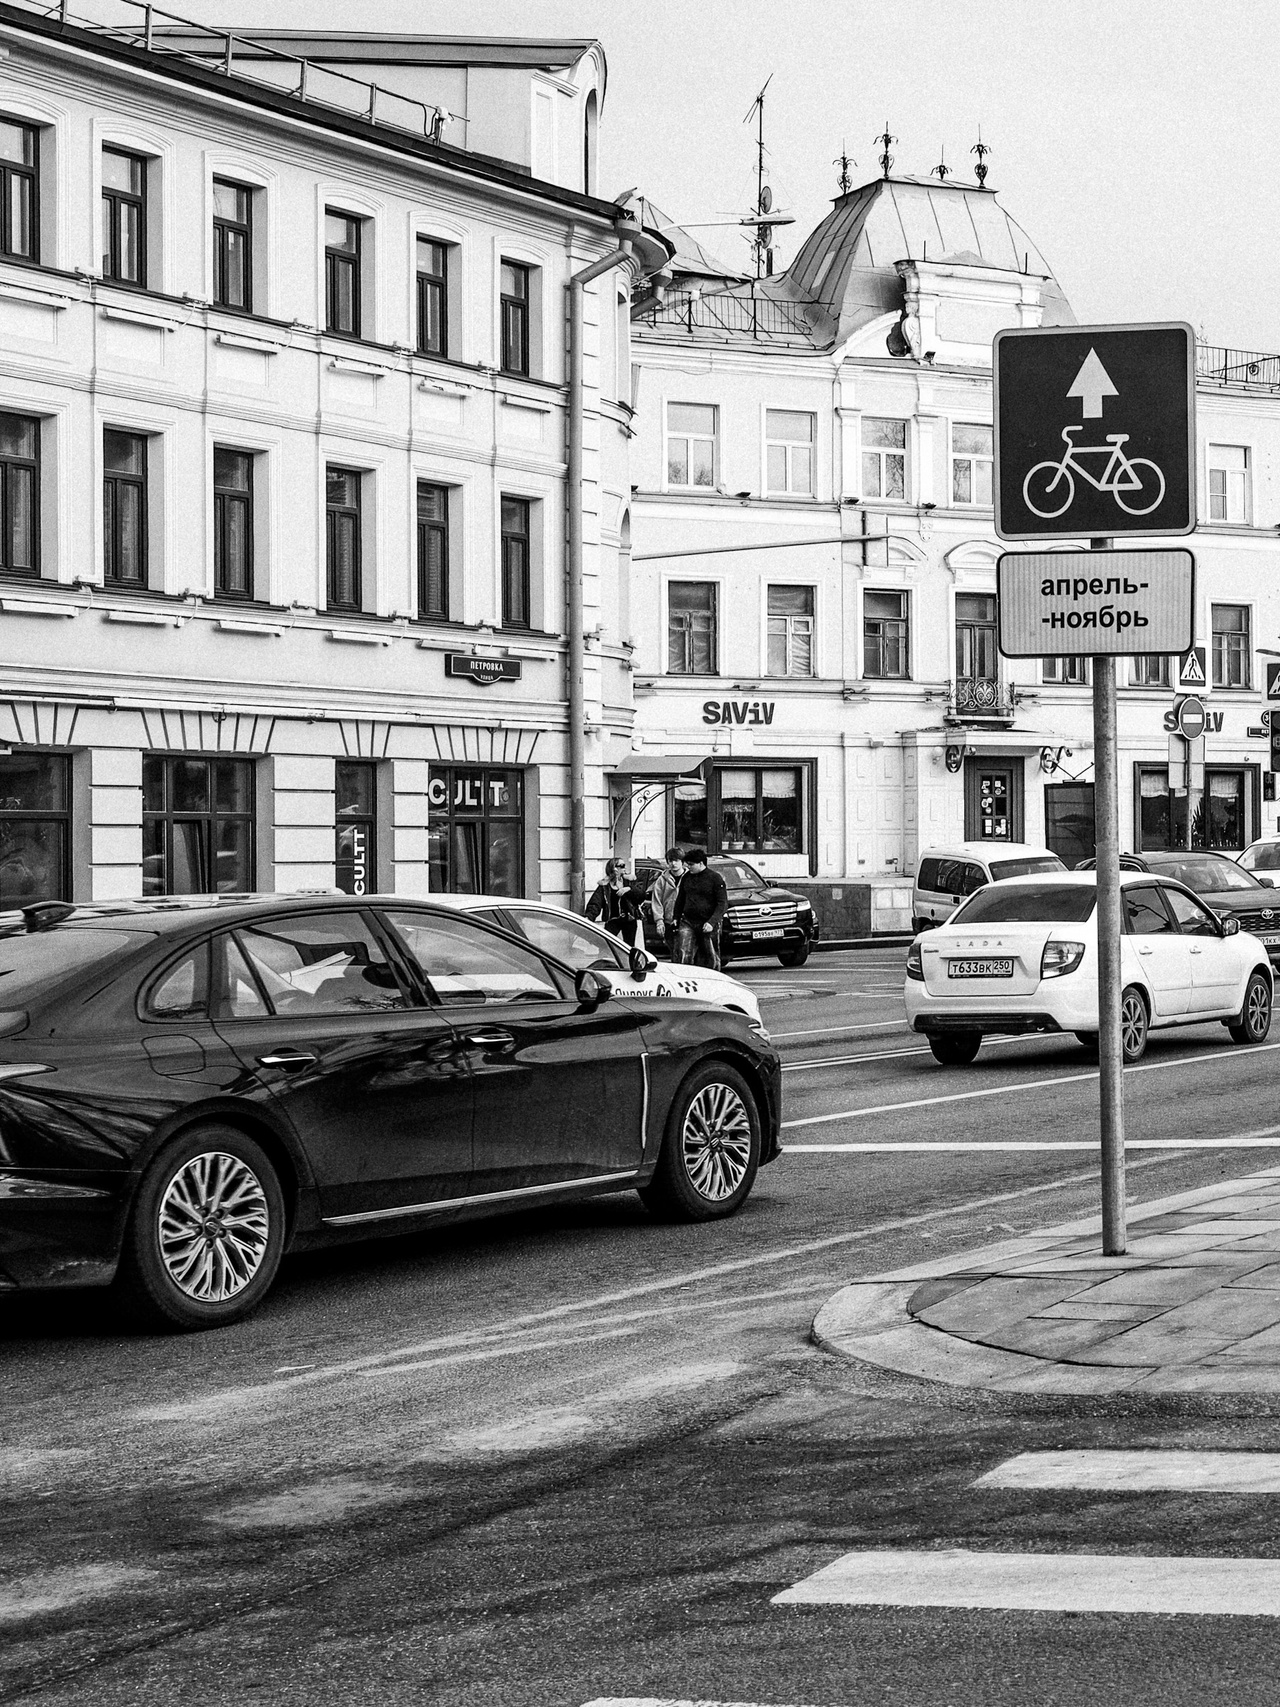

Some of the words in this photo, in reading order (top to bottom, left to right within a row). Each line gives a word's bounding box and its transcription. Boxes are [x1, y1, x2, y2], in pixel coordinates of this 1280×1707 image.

[1040, 577, 1149, 601] апрель-
[1041, 604, 1149, 633] -ноябрь
[470, 661, 504, 672] ПЕТРОВКА
[1163, 711, 1224, 732] SiV
[354, 829, 365, 896] CULTT
[952, 961, 992, 974] Т633ВК
[993, 961, 1010, 970] 250
